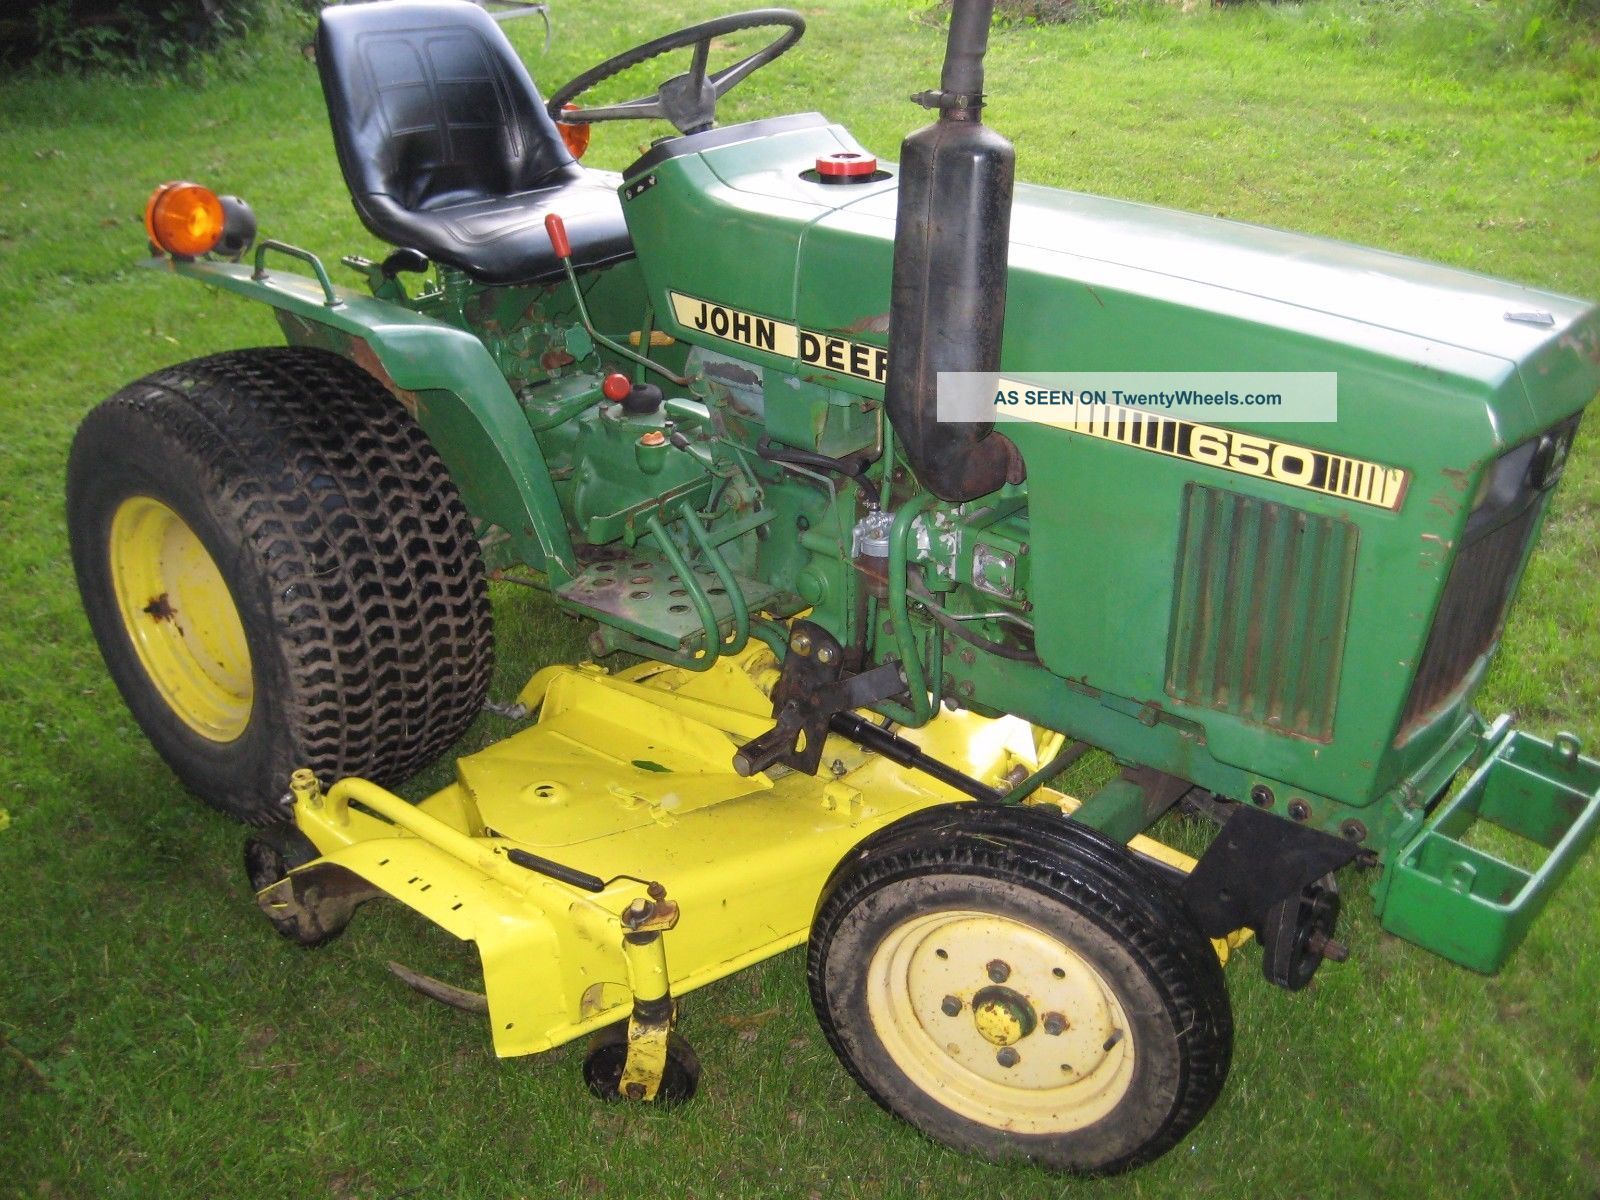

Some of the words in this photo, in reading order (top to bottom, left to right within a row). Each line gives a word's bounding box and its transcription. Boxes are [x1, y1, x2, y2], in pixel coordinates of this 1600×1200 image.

[694, 303, 775, 351] JOHN
[800, 332, 888, 381] DEER
[1189, 425, 1315, 485] 650
